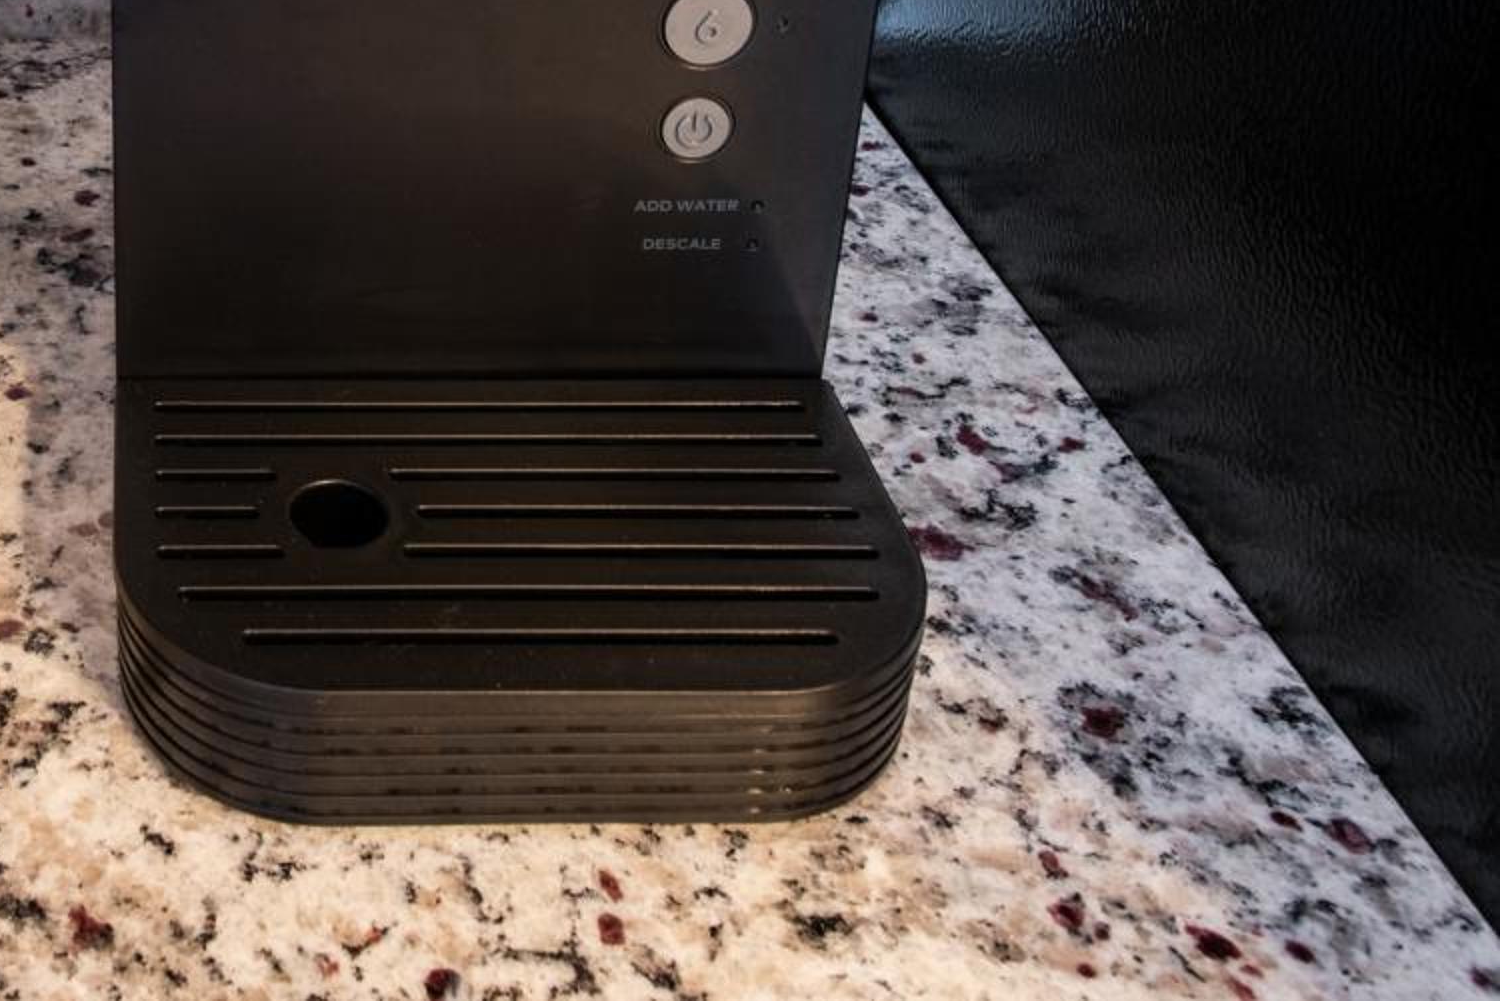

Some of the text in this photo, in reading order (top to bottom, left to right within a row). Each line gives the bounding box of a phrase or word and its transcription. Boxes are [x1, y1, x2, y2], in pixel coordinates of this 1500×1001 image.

[694, 8, 722, 45] 6
[633, 199, 741, 213] ADD WATER
[642, 238, 722, 250] DESCALE
